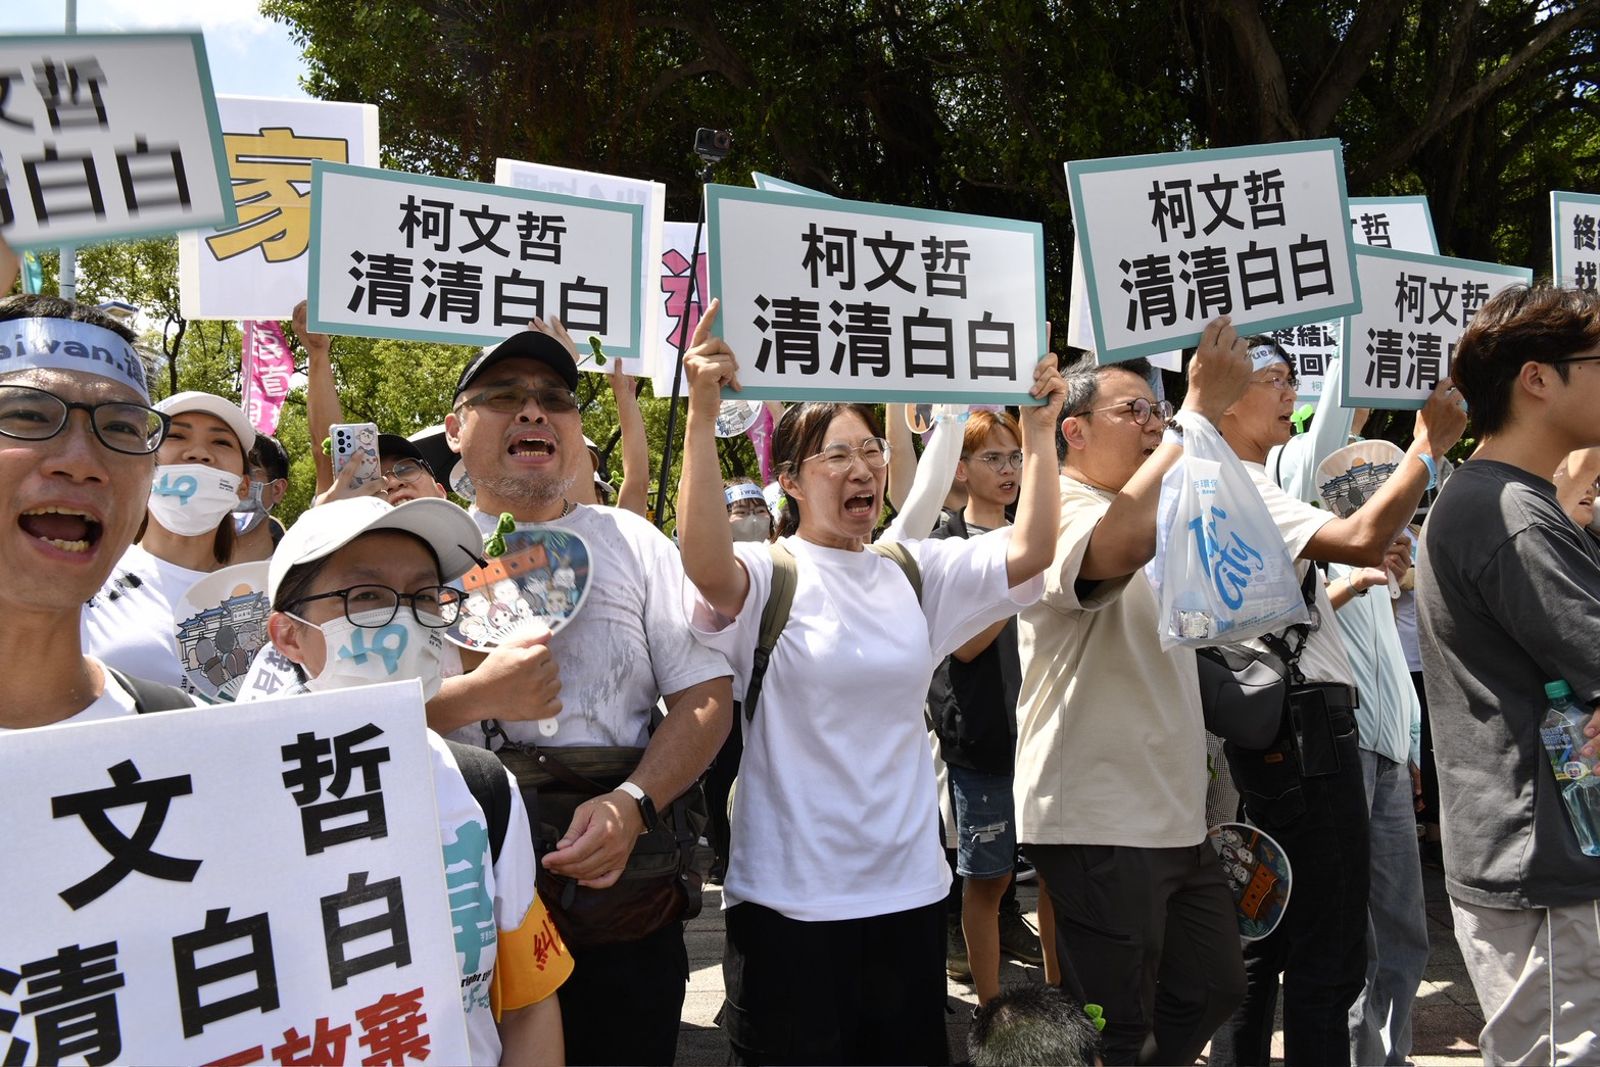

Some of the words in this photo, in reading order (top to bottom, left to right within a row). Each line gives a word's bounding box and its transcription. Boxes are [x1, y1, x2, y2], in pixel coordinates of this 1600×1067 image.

[0, 135, 192, 227] 白白
[1148, 168, 1286, 243] 柯文哲
[398, 195, 567, 265] 柯文哲
[801, 223, 970, 299] 柯文哲
[1350, 213, 1392, 248] 哲
[1573, 214, 1600, 250] 終
[347, 250, 609, 336] 清清白白
[1118, 233, 1335, 332] 清清白白
[1395, 271, 1490, 328] 柯文哲
[1575, 261, 1600, 293] 找
[752, 294, 1016, 381] 清清白白
[1364, 327, 1457, 390] 清清
